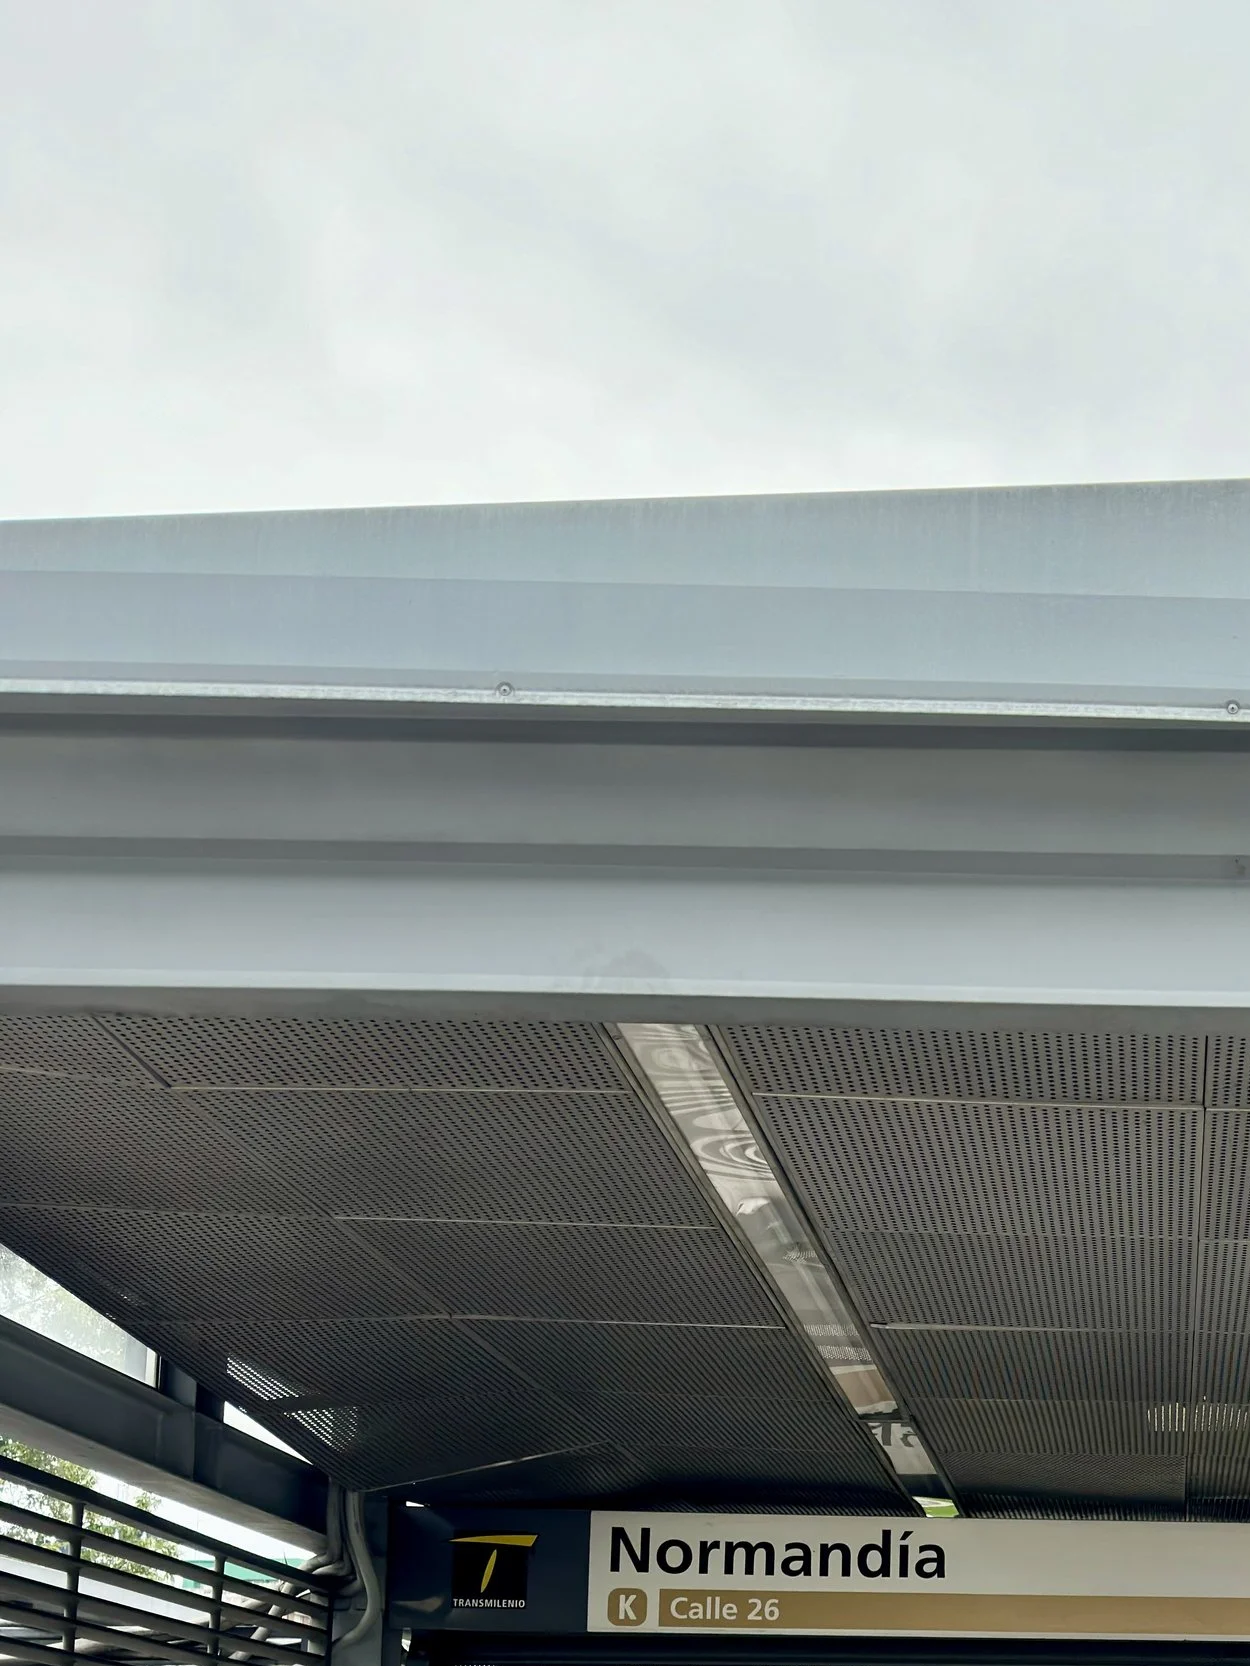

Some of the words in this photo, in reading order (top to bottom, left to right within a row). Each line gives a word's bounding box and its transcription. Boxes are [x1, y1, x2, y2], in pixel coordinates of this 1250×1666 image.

[609, 1526, 946, 1580] Normandía
[452, 1598, 526, 1608] TRANSMILENIO
[618, 1594, 637, 1621] K
[670, 1596, 738, 1620] Calle
[747, 1598, 780, 1621] 26
